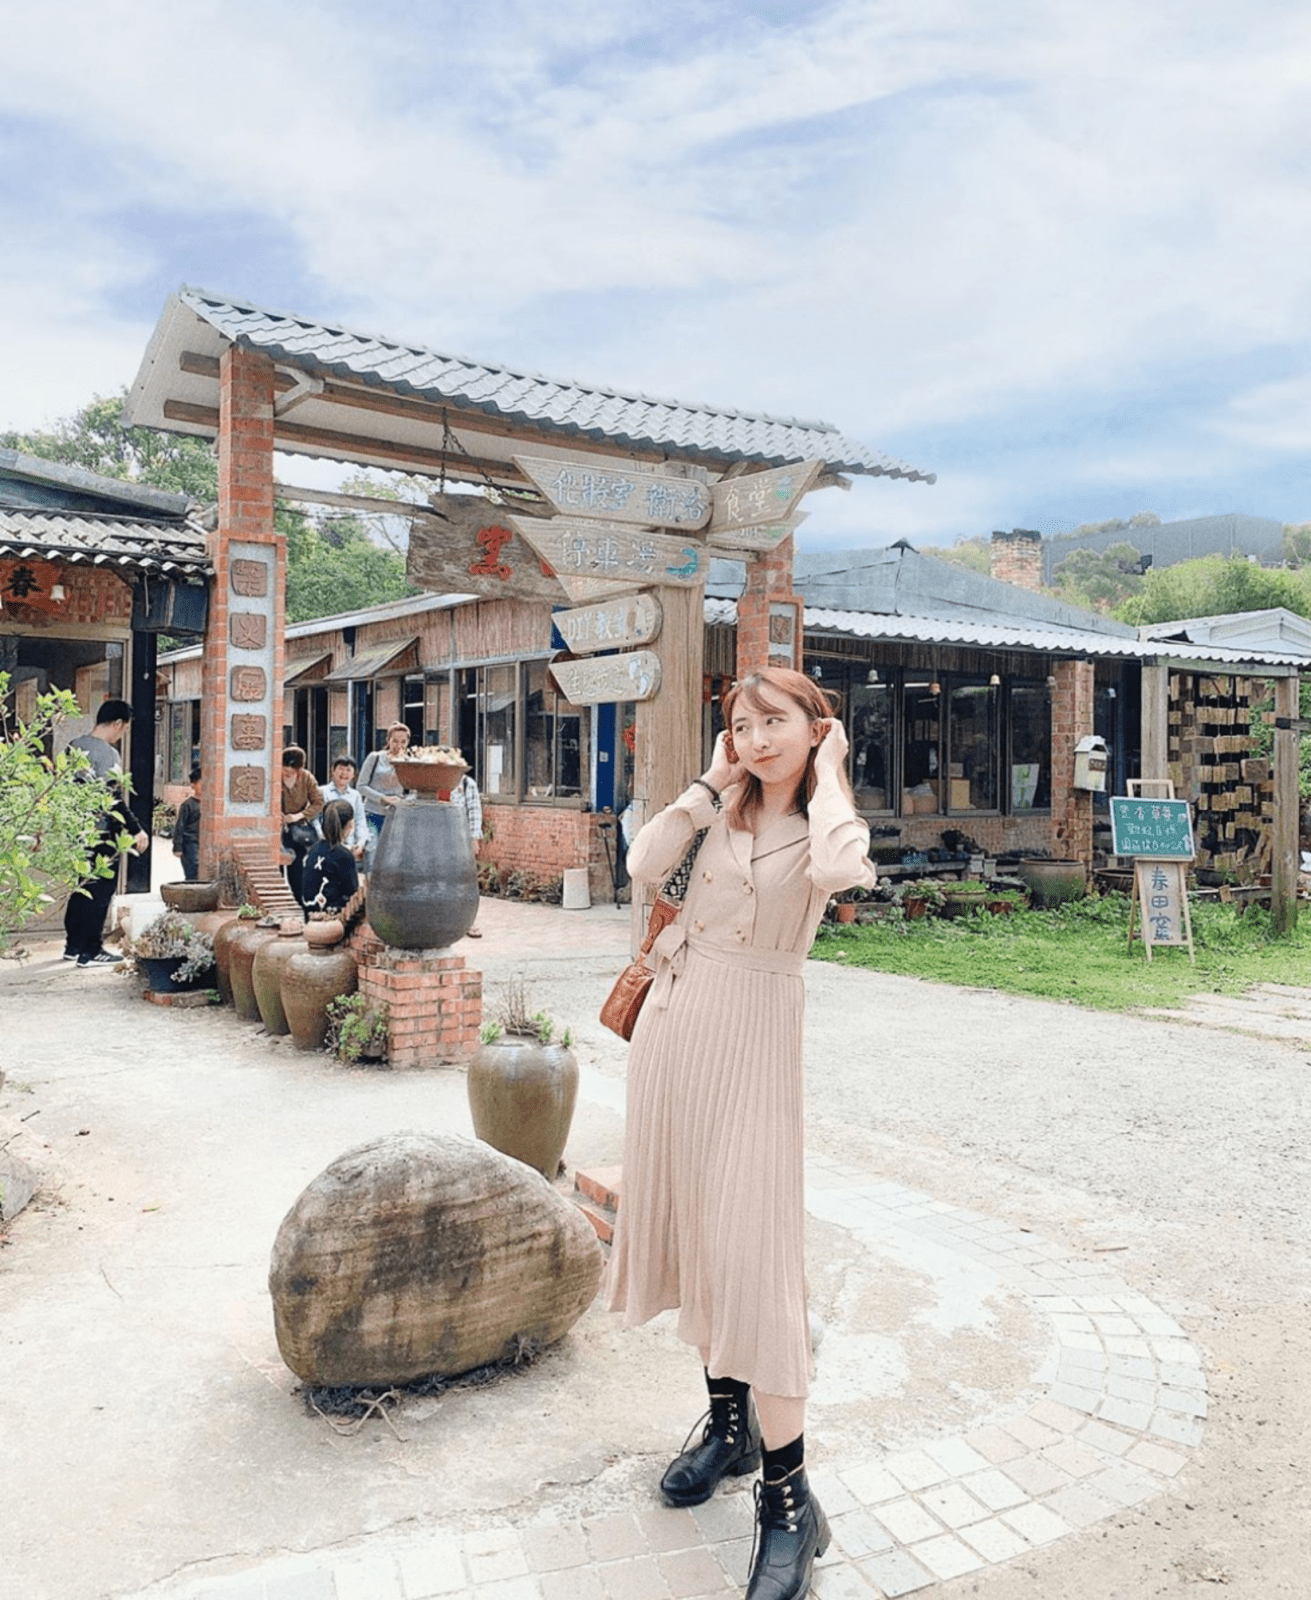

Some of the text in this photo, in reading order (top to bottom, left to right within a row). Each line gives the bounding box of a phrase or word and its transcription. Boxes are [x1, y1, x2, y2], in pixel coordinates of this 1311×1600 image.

[724, 478, 772, 522] 食堂
[558, 531, 657, 573] 停車場
